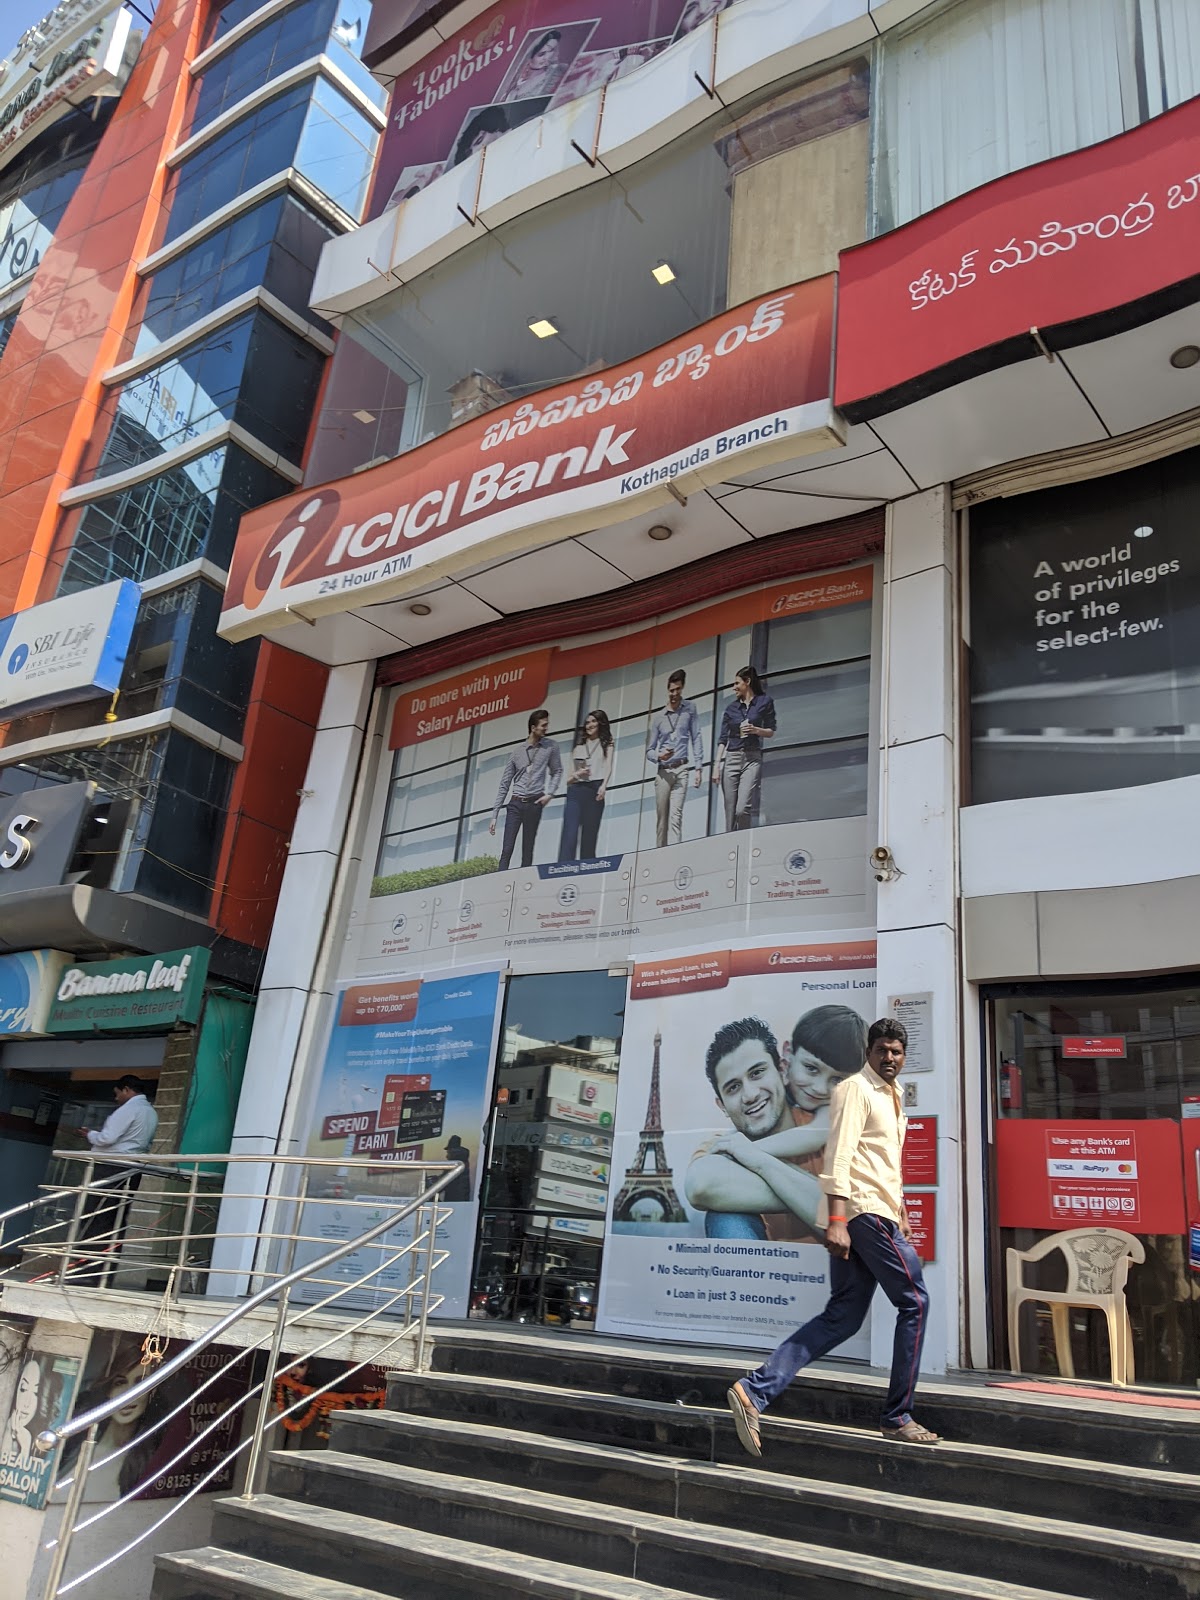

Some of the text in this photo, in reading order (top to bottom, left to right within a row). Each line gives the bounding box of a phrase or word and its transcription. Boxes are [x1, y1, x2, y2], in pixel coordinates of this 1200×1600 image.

[394, 26, 516, 130] Fabulous!
[412, 39, 476, 95] Look
[908, 248, 980, 311] కోటక్
[619, 417, 789, 495] Kothaguda Branch
[325, 425, 637, 567] ICICI Bank
[1033, 543, 1131, 578] A world
[318, 553, 413, 595] 24 Hour ATM
[1034, 559, 1180, 602] of privileges
[826, 581, 859, 595] Bank
[1035, 601, 1120, 627] for the
[29, 631, 61, 655] SBI
[1036, 617, 1164, 652] select-few.
[411, 667, 526, 715] Do more with your
[416, 694, 510, 737] Salary Account
[580, 860, 612, 871] Benefits
[807, 953, 834, 963] Bank
[58, 968, 147, 1002] Banana
[641, 978, 660, 988] dream
[801, 980, 877, 991] Personal Loan
[86, 1002, 128, 1019] Cuisine
[131, 998, 185, 1016] Restaurant
[358, 991, 419, 1004] Get benefits worth
[367, 1005, 375, 1014] to
[328, 1116, 370, 1135] SPEND
[358, 1133, 389, 1151] EARN
[1052, 1137, 1130, 1147] Use any Bank's card
[1081, 1147, 1096, 1155] this
[1097, 1147, 1116, 1155] ATM
[1053, 1163, 1107, 1173] VISA RuPay
[675, 1243, 799, 1259] Minimal documentation
[657, 1264, 671, 1275] No
[768, 1270, 826, 1285] required
[673, 1288, 695, 1300] Loan
[697, 1288, 706, 1300] in
[707, 1289, 727, 1303] just
[729, 1290, 737, 1301] 3
[0, 1450, 51, 1477] BEAUTY
[0, 1468, 41, 1495] SALON
